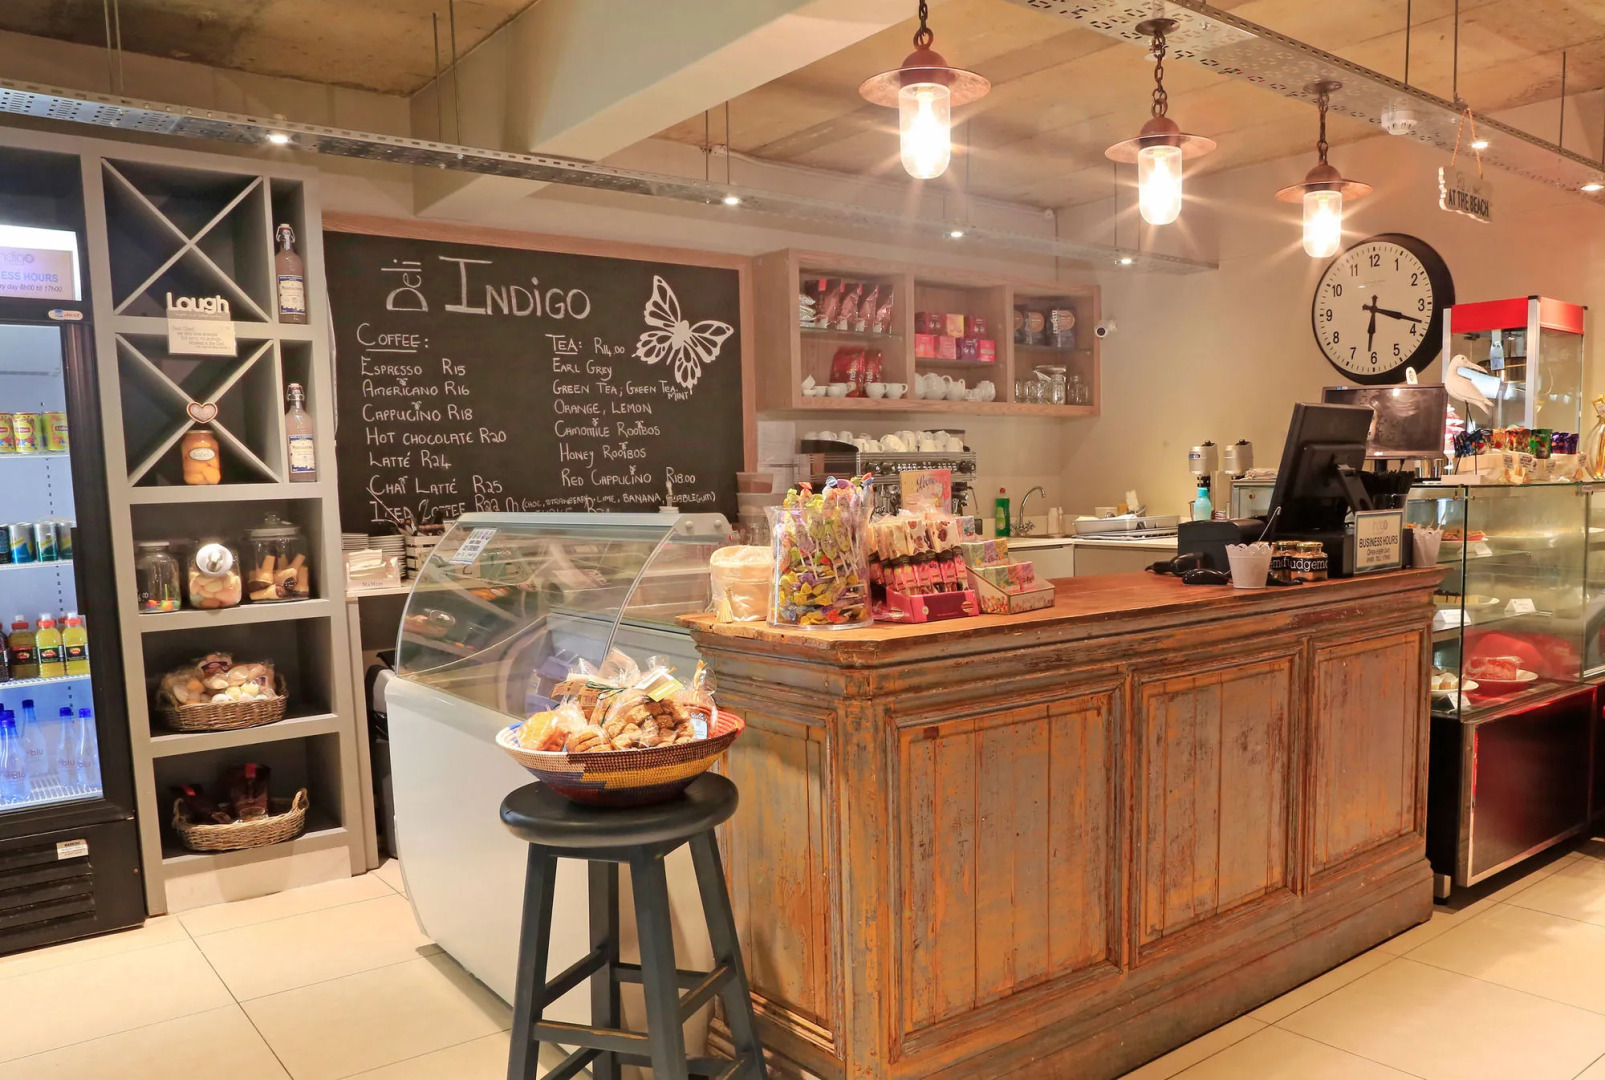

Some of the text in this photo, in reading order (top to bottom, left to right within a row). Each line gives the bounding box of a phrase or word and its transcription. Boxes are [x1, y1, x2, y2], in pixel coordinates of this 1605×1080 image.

[1448, 188, 1489, 217] AT THE BEACH
[1369, 253, 1380, 268] 12
[1394, 258, 1399, 272] 1
[23, 271, 59, 282] HOURS
[1350, 263, 1359, 276] 11
[1411, 273, 1418, 286] 2
[1332, 284, 1342, 297] 10
[166, 292, 230, 315] Laugh
[1417, 298, 1425, 311] 3
[1326, 309, 1333, 321] 9
[357, 323, 429, 349] COFFEE:
[1409, 323, 1417, 336] 4
[545, 334, 583, 352] TEA:
[1332, 331, 1340, 344] 8
[1350, 346, 1357, 360] 7
[1393, 343, 1400, 356] 5
[1370, 351, 1378, 364] 6
[361, 356, 466, 376] ESPRESSO R15
[552, 358, 580, 373] EARL
[363, 379, 470, 398] AMERICANO R16
[552, 379, 590, 395] GREEN
[626, 381, 657, 394] GREEN
[667, 391, 689, 401] MINT
[363, 404, 473, 422] CAPPUCINO R18
[611, 401, 653, 415] LEMON
[366, 427, 507, 445] HOT CHOCOLATE R20
[555, 420, 661, 438] CAMOMILE ROOIBOS
[421, 450, 452, 469] R24
[603, 444, 647, 460] ROOIBOS
[472, 475, 503, 494] R25
[561, 467, 696, 487] RED CAPPUCINO R18.00
[475, 494, 500, 512] R22
[1359, 535, 1398, 548] BUSINESS HOURS
